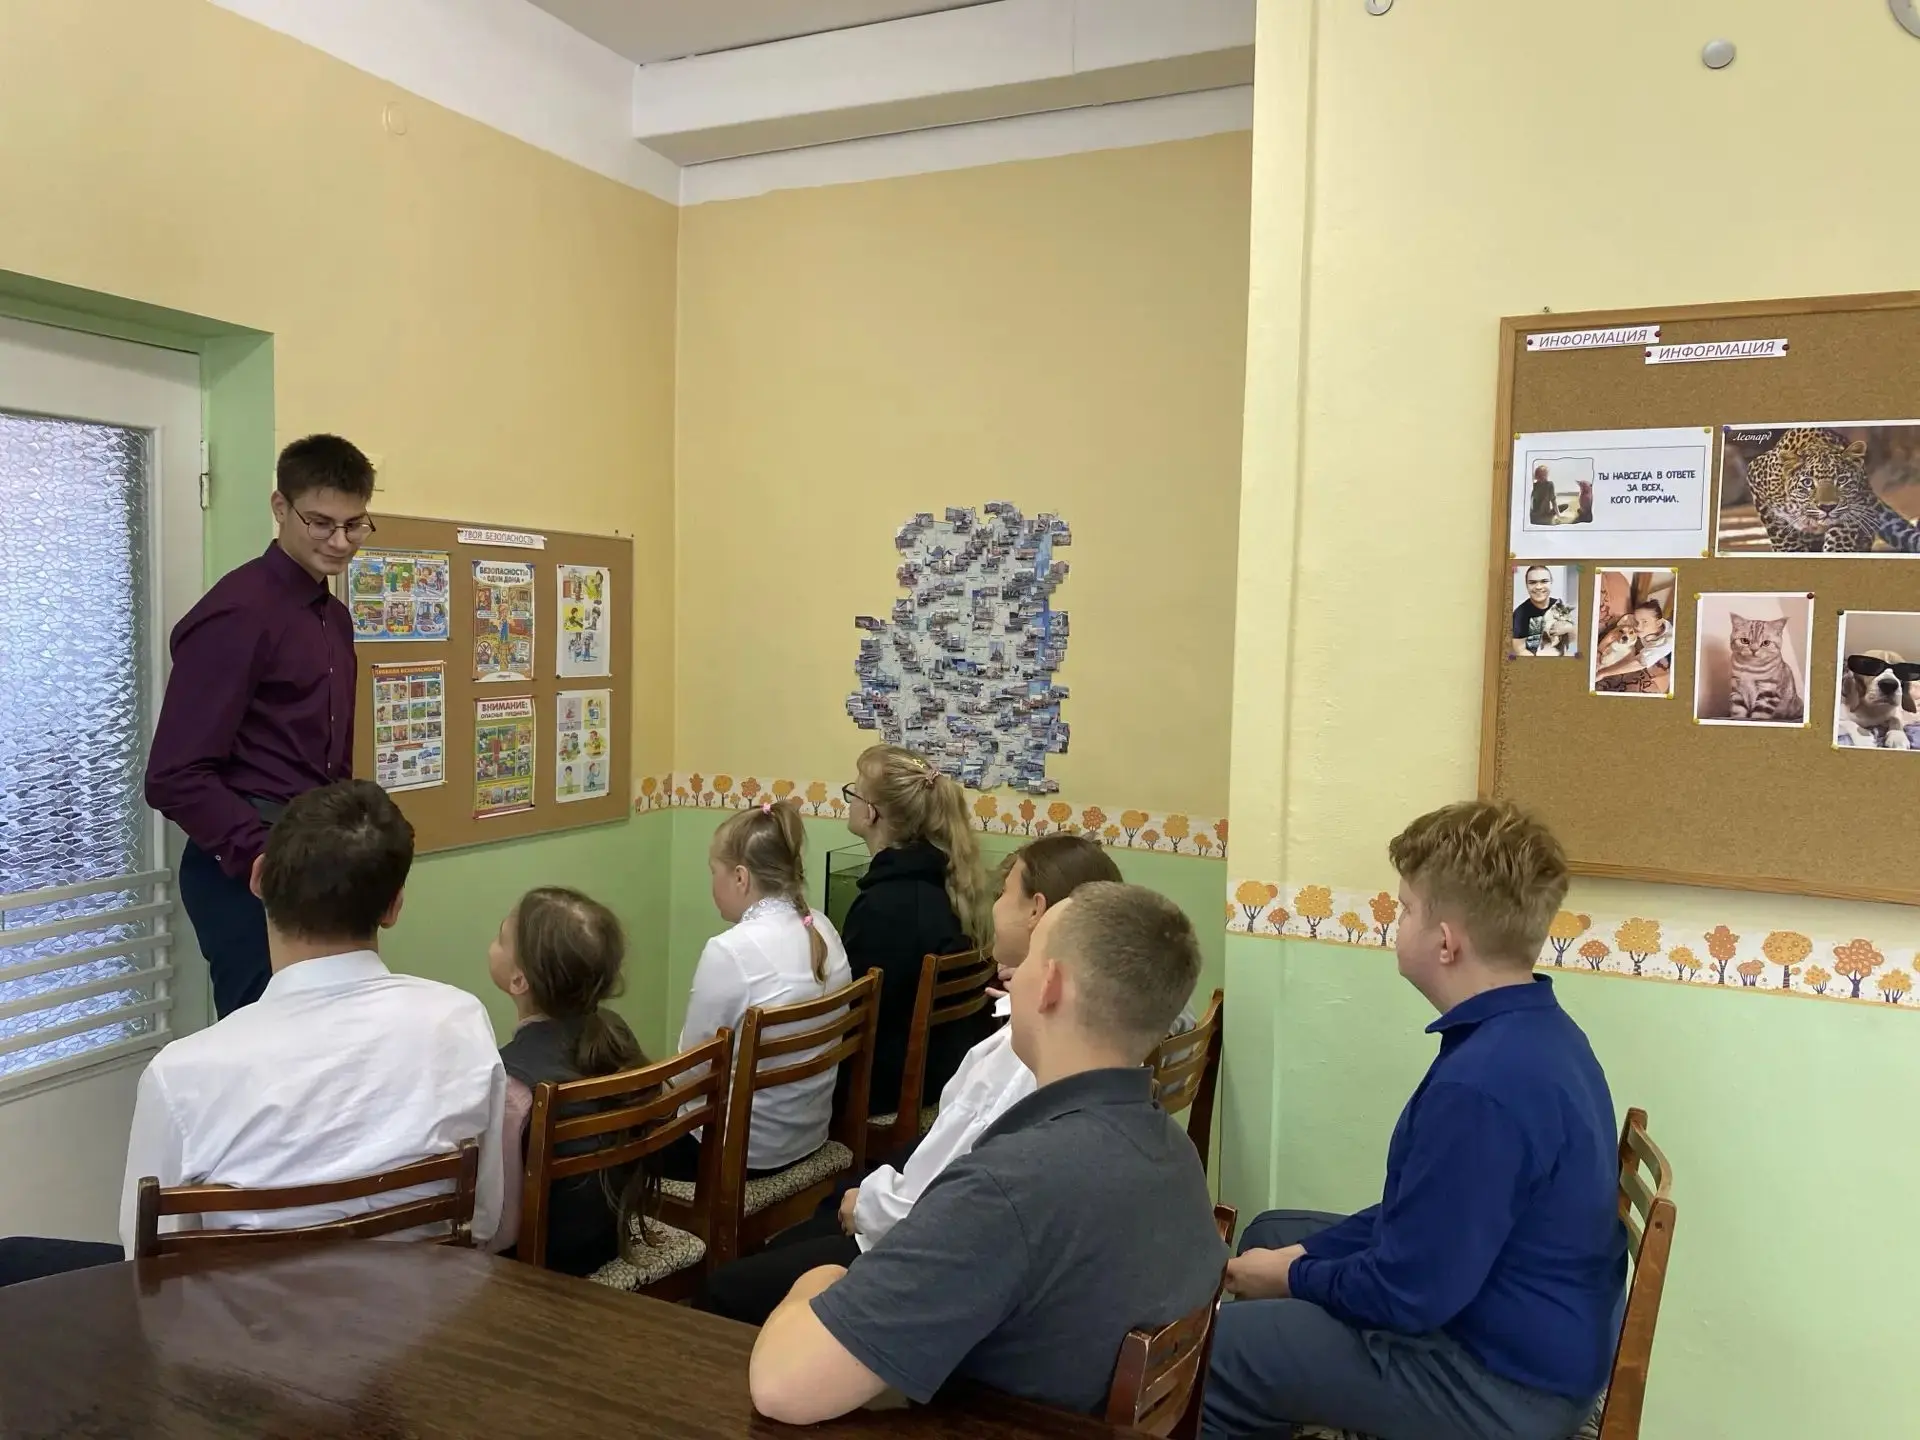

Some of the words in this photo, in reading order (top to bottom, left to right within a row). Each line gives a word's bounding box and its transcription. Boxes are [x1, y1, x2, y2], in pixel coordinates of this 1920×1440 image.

[1539, 329, 1648, 348] ИНФОРМАЦИЯ
[1659, 341, 1775, 360] ИНФОРМАЦИЯ
[1599, 472, 1610, 481] ТЫ
[1612, 470, 1653, 481] НАВСЕГДА
[1656, 471, 1663, 480] В
[1666, 469, 1696, 479] ОТВЕТЕ
[1626, 483, 1638, 492] ЗА
[1641, 483, 1664, 493] ВСЕХ,
[1610, 495, 1632, 505] КОГО
[1634, 494, 1680, 504] ПРИРУЧИЛ.
[463, 530, 483, 539] ТВОЯ
[485, 531, 534, 544] БЕЗОПАСНОСТЬ
[482, 701, 529, 711] ВНИМАНИЕ:
